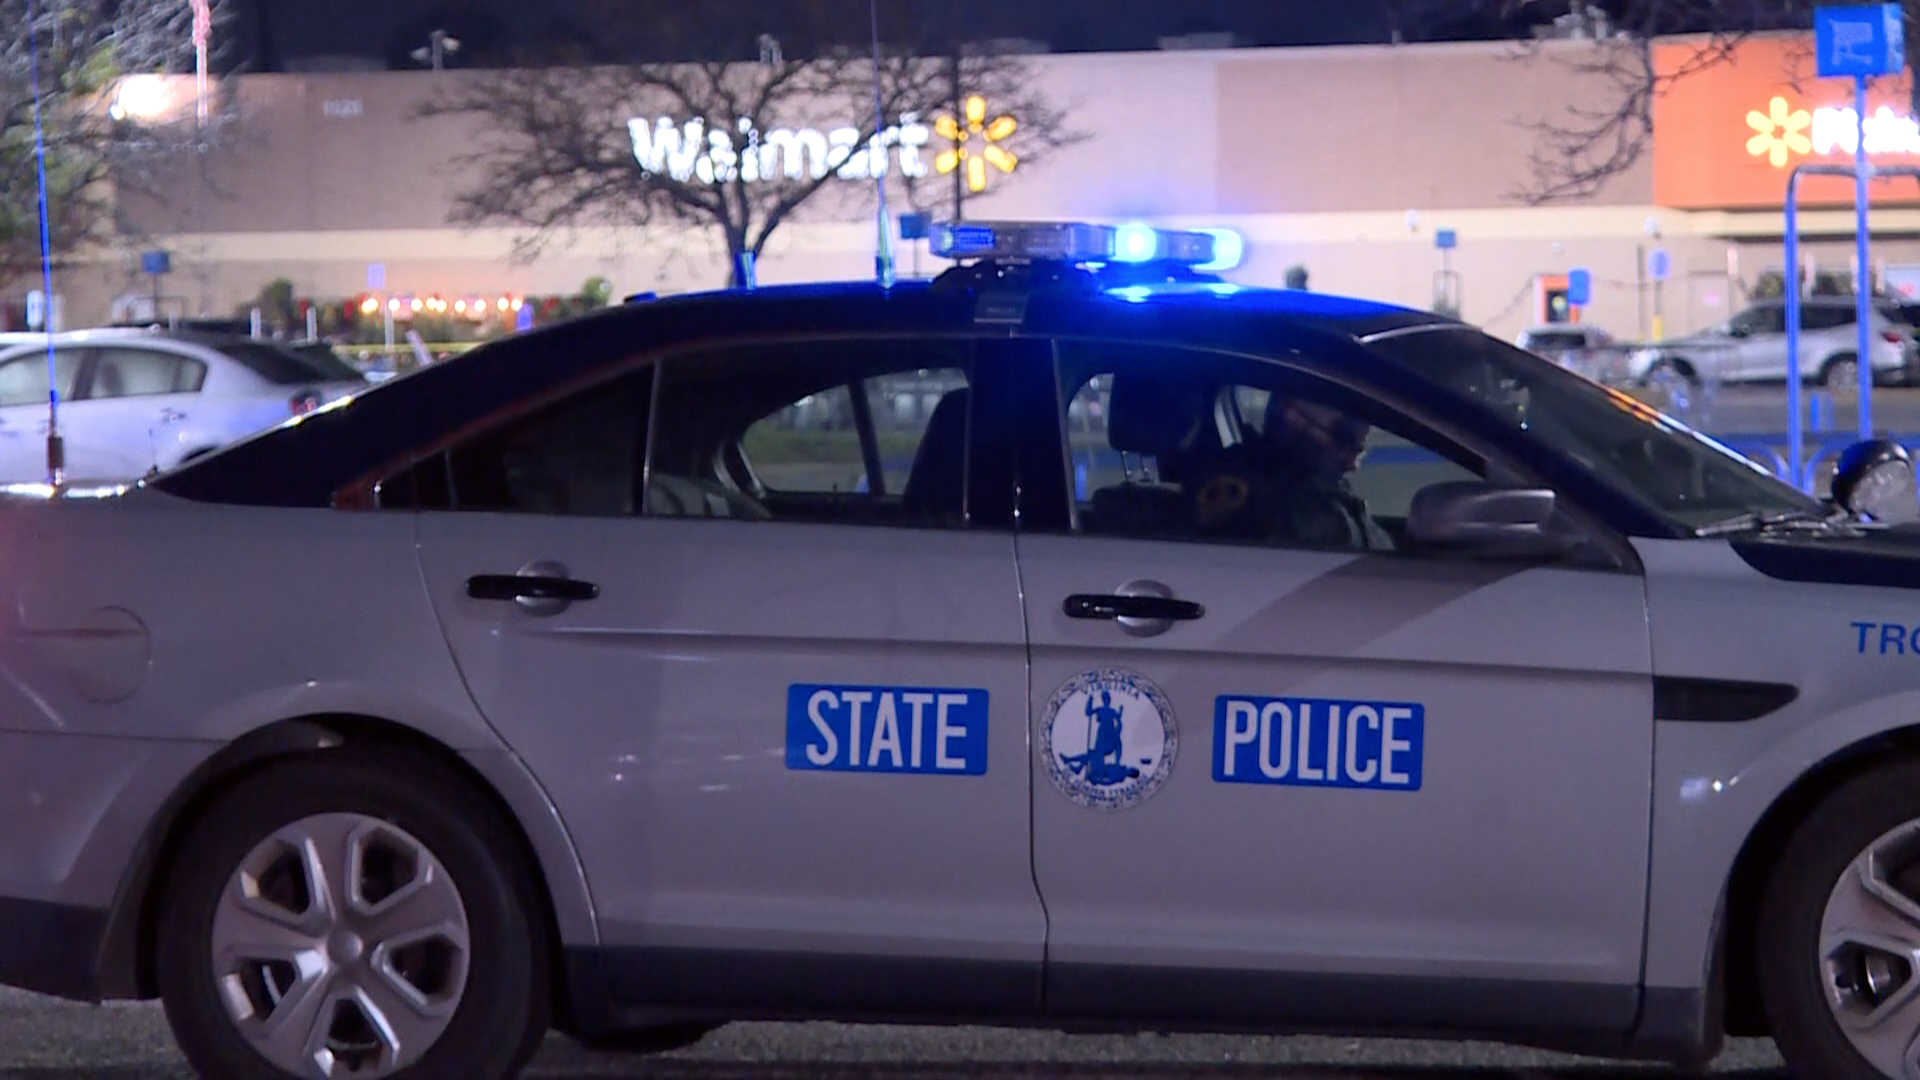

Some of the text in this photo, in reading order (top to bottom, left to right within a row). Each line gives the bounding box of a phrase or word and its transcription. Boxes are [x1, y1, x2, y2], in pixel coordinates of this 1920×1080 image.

[627, 114, 929, 184] Walmart
[806, 690, 1412, 783] STATE POLICE
